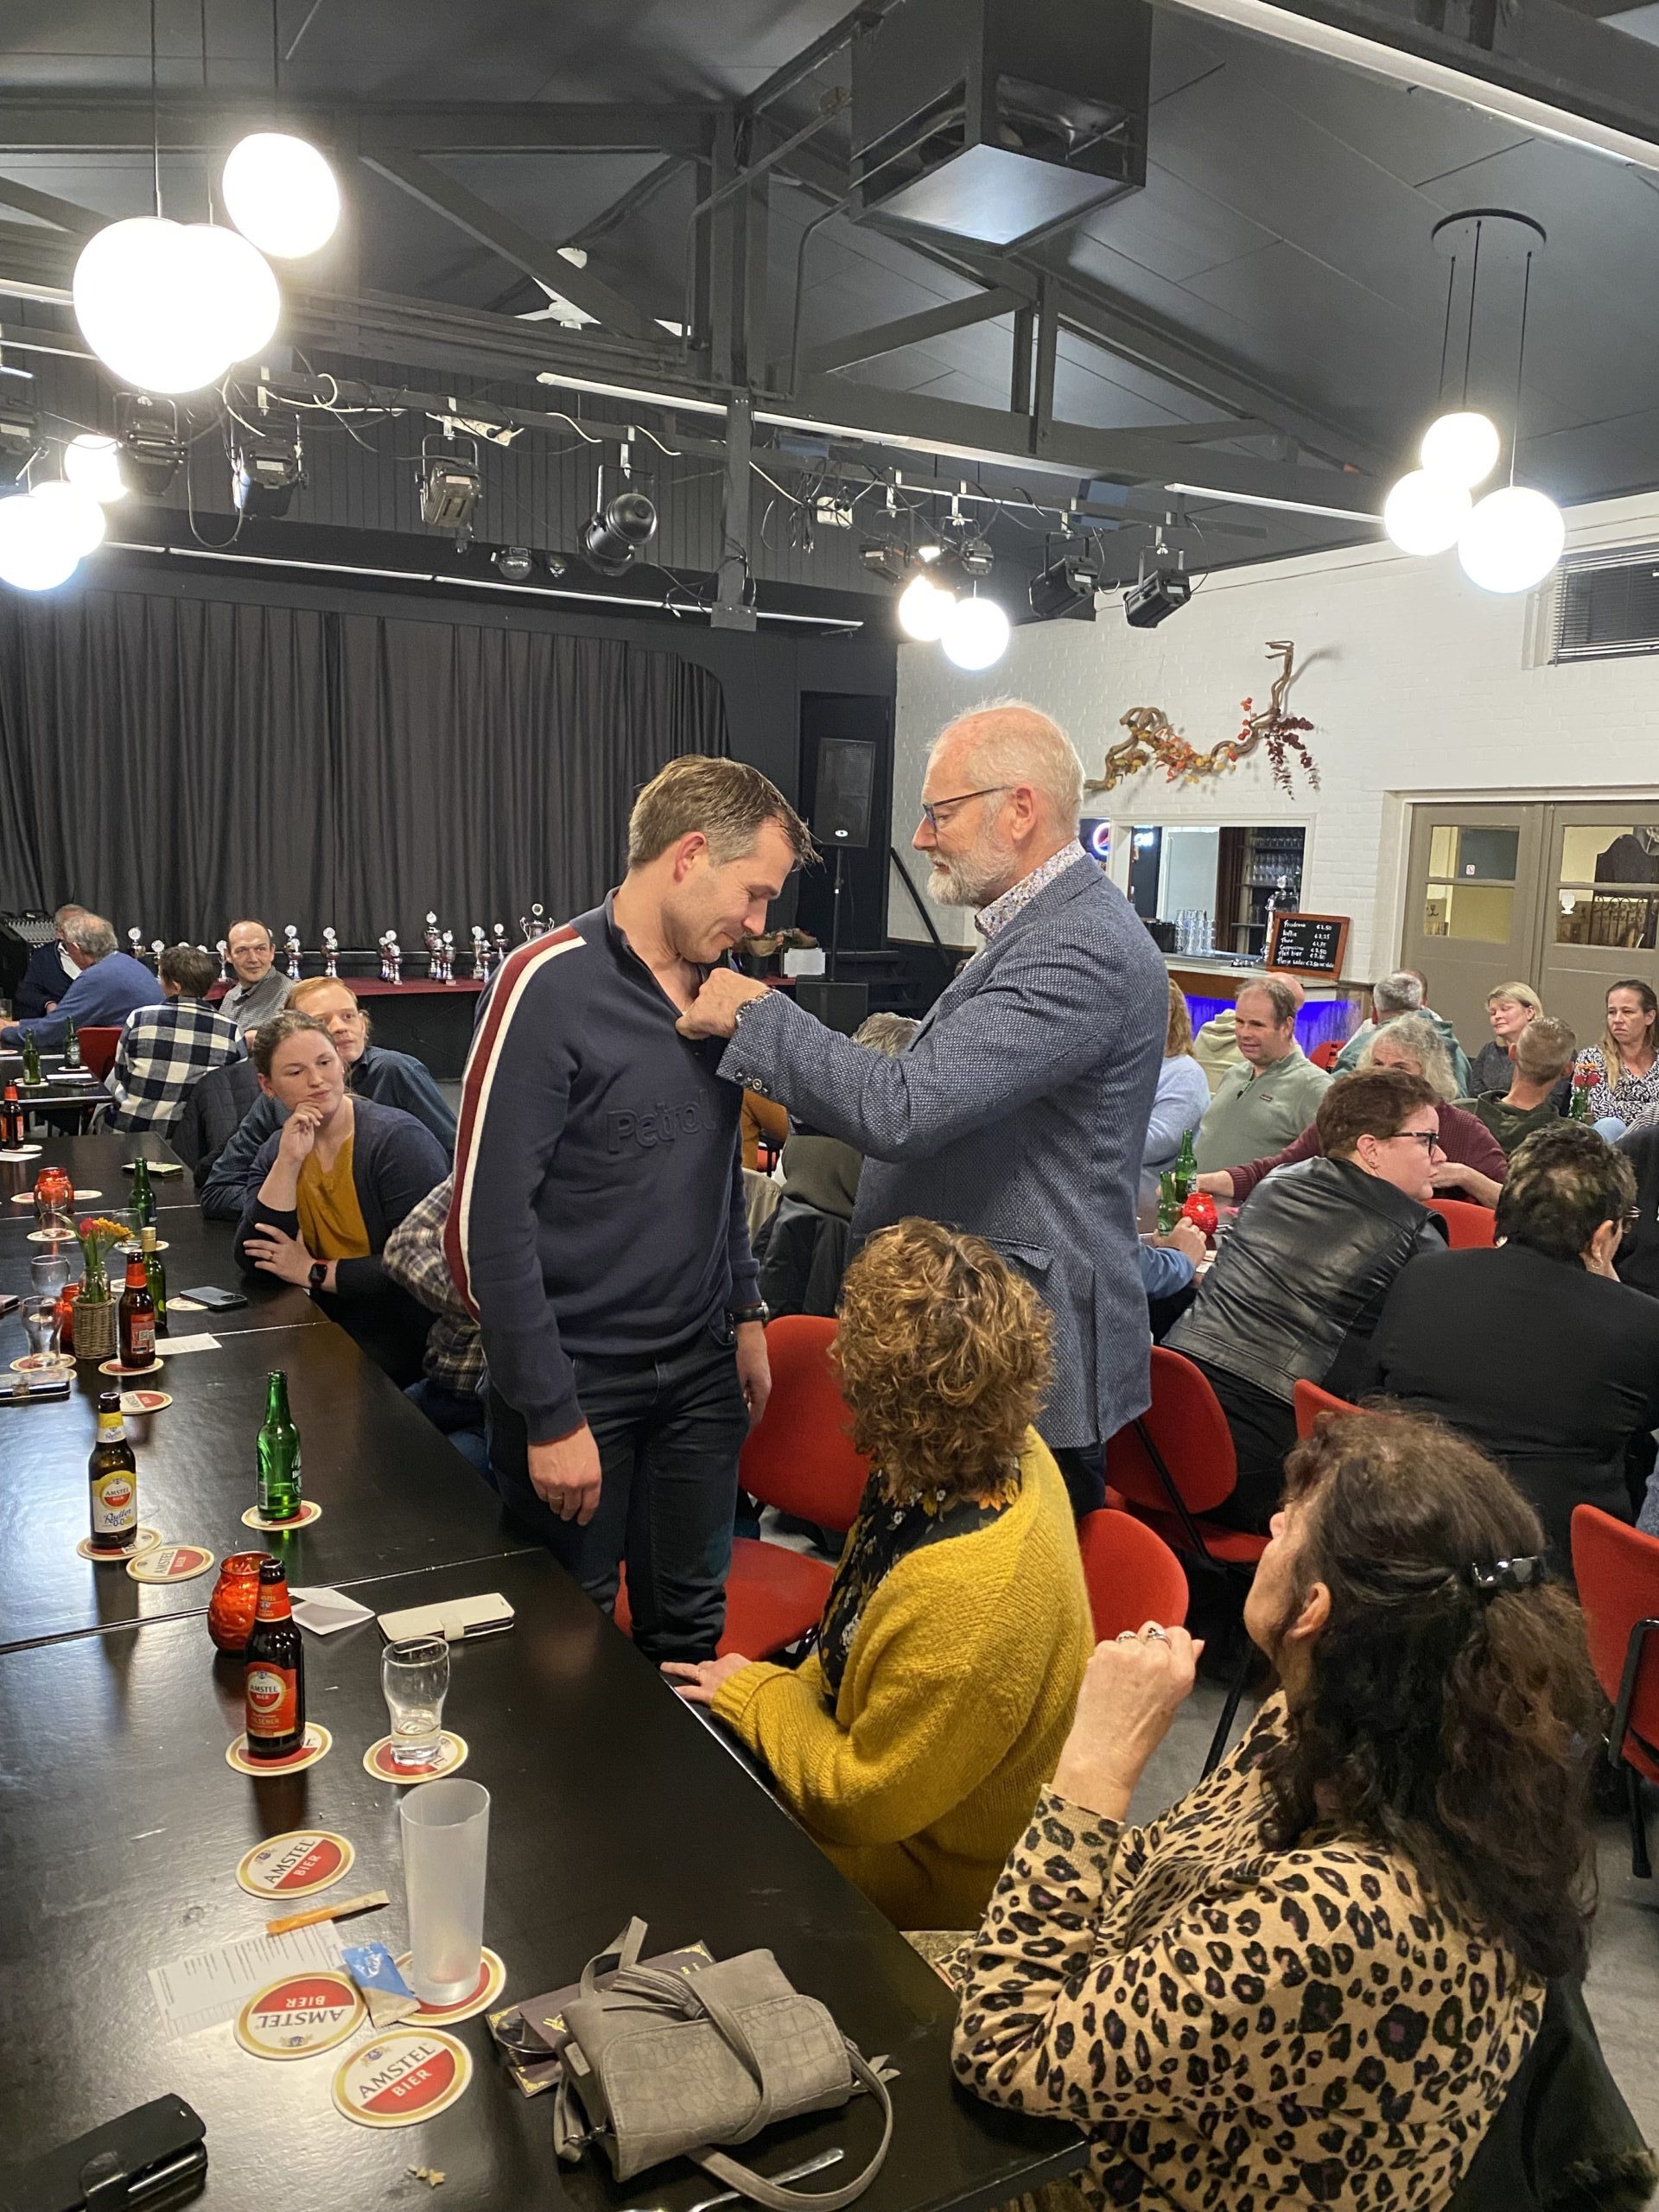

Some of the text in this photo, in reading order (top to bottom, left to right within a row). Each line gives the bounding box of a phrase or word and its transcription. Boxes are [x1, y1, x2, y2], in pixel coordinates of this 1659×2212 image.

[105, 1487, 130, 1496] AMSTEL
[104, 1509, 131, 1524] Radler
[154, 1551, 175, 1573] AMSTEL
[174, 1556, 187, 1568] BIER
[250, 1684, 277, 1693] AMSTEL
[264, 1840, 315, 1884] AMSTEL
[293, 1854, 321, 1877] BIER
[286, 1995, 326, 2008] BIER
[257, 2008, 346, 2029] AMSTEL
[359, 2045, 435, 2099] AMSTEL
[391, 2069, 432, 2097] BIER
